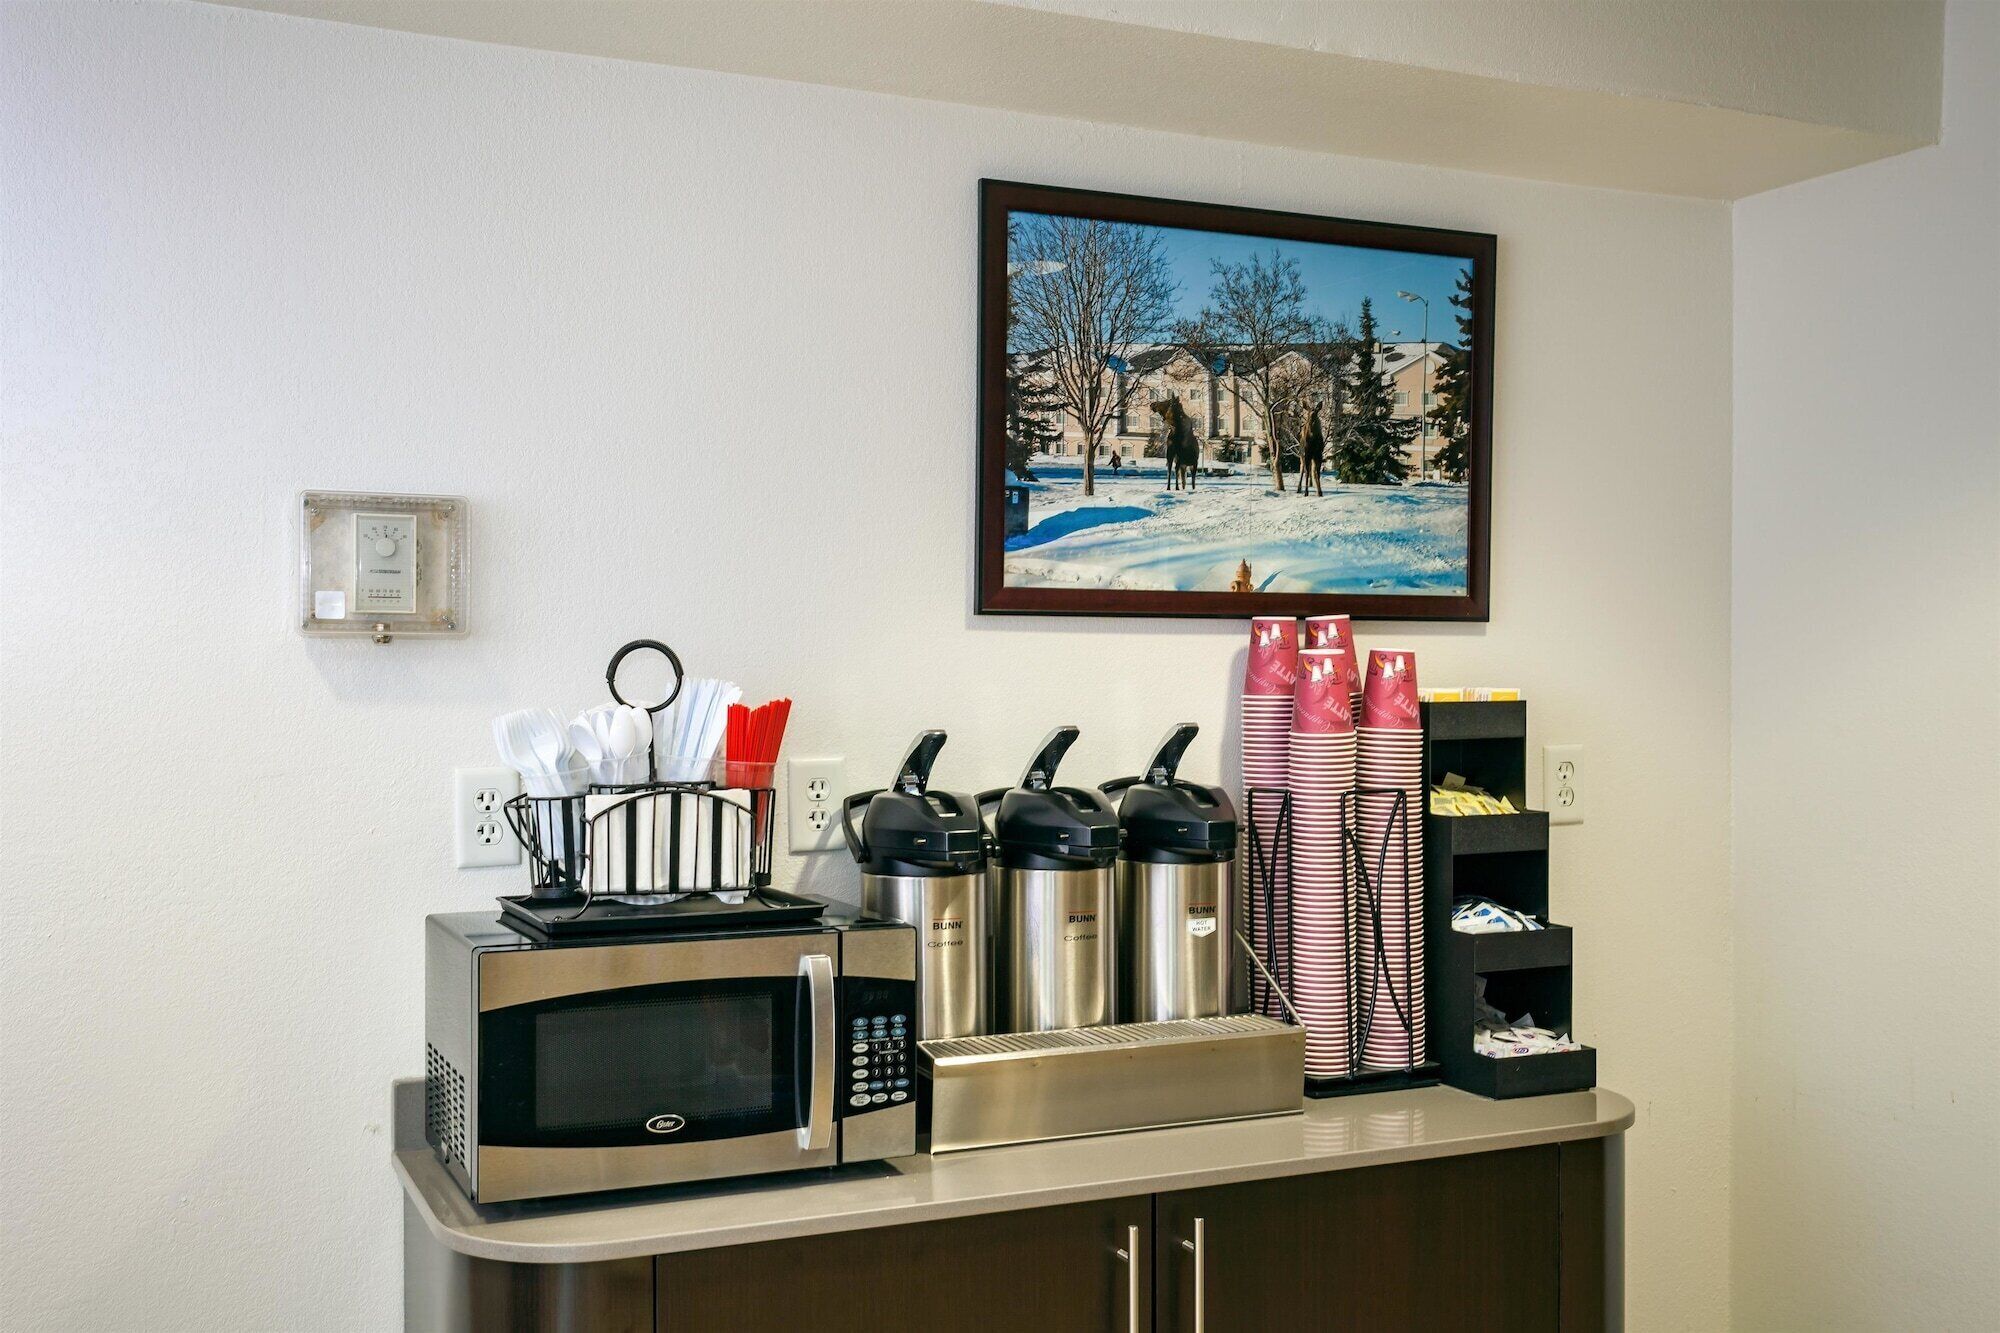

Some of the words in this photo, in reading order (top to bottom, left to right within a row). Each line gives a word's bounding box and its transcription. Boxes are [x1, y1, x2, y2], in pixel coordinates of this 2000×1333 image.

[1268, 660, 1297, 685] ATTÉ
[1188, 905, 1216, 914] BUNN
[1068, 914, 1096, 923] BUNN
[932, 921, 962, 930] BUNN
[1063, 934, 1098, 942] Coffee
[927, 940, 964, 948] Coffee
[656, 1120, 676, 1129] Oster
